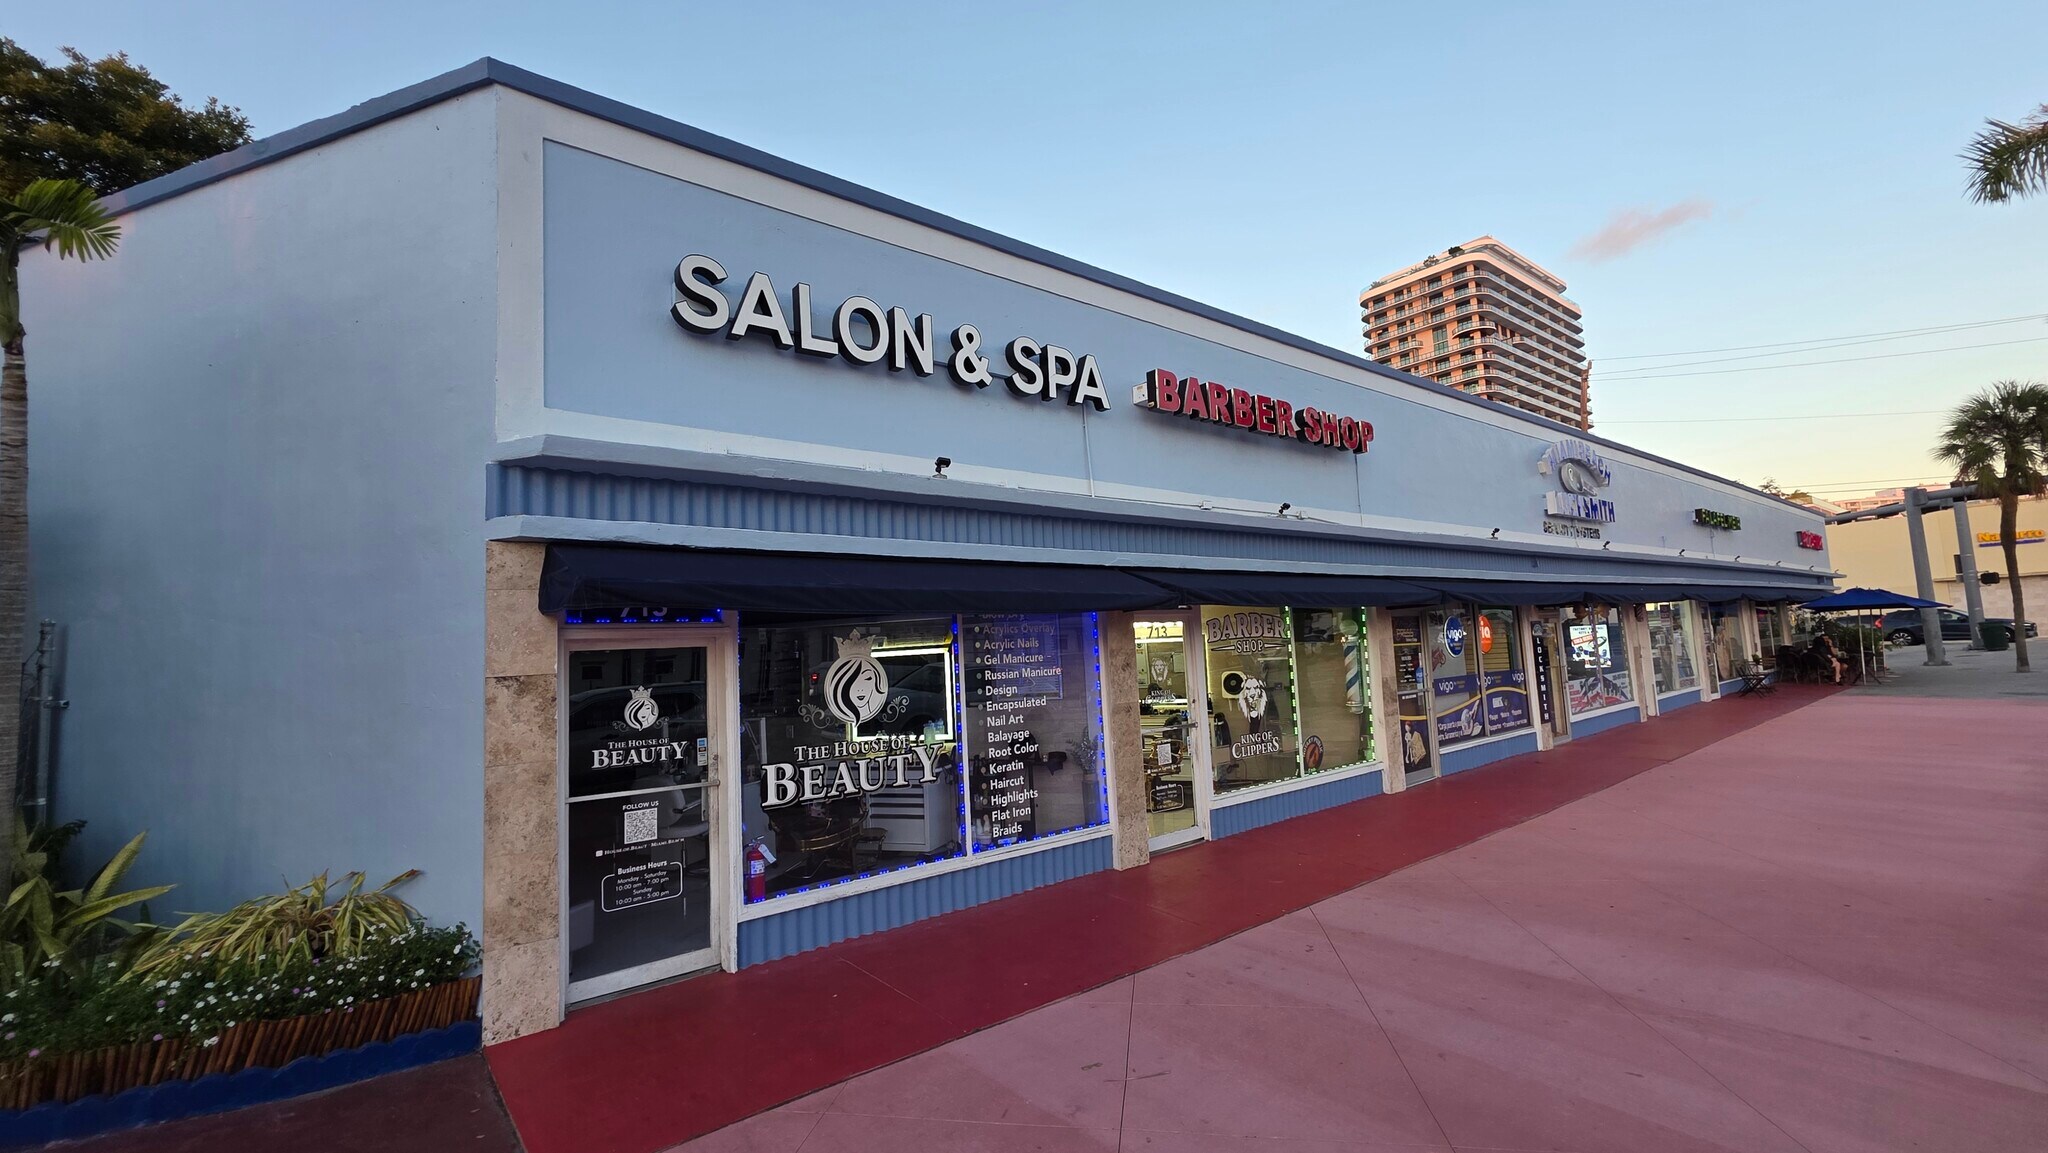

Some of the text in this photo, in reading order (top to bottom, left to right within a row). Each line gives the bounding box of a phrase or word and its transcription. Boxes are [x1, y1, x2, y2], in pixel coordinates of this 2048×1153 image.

[671, 254, 1111, 411] SALON & SPA
[1155, 369, 1375, 453] BARBER SHOP
[1546, 491, 1616, 523] KSMITH
[1977, 529, 2045, 543] Narro
[983, 623, 1055, 637] Acrylics Overlay
[1147, 625, 1168, 639] 713
[1206, 612, 1286, 643] BARBER
[1447, 626, 1463, 642] vigo
[983, 637, 1040, 652] Acrylic Nails
[1235, 639, 1264, 653] SHOP
[984, 652, 1044, 665] Gel Manicure
[984, 666, 1062, 681] Russian Manicure
[1512, 671, 1525, 683] vigo
[1536, 637, 1550, 720] LOCKSMITH
[1439, 680, 1454, 693] vigo
[1476, 676, 1492, 688] vgo
[985, 684, 1018, 697] Design
[986, 695, 1047, 712] Encapsulated
[987, 713, 1024, 727] Nail Art
[987, 729, 1030, 743] Balayage
[1241, 731, 1273, 744] KING OF
[608, 741, 627, 749] THE
[628, 739, 657, 747] HOUSE
[793, 737, 911, 763] THE HOUSE OF
[988, 742, 1039, 759] Root Color
[1232, 736, 1280, 759] CLIPPERS
[591, 740, 689, 770] BEAUTY
[989, 760, 1024, 775] Keratin
[761, 743, 944, 811] BEAUTY
[990, 775, 1025, 790] Haircut
[991, 789, 1039, 807] Highlights
[622, 802, 650, 810] FOLLOW
[992, 806, 1031, 822] Flat Iron
[992, 822, 1023, 838] Braids
[617, 861, 668, 875] Business Hours
[617, 876, 639, 884] Monday
[644, 870, 667, 879] Saturday
[616, 884, 632, 892] 10:00
[633, 887, 653, 895] Sunday
